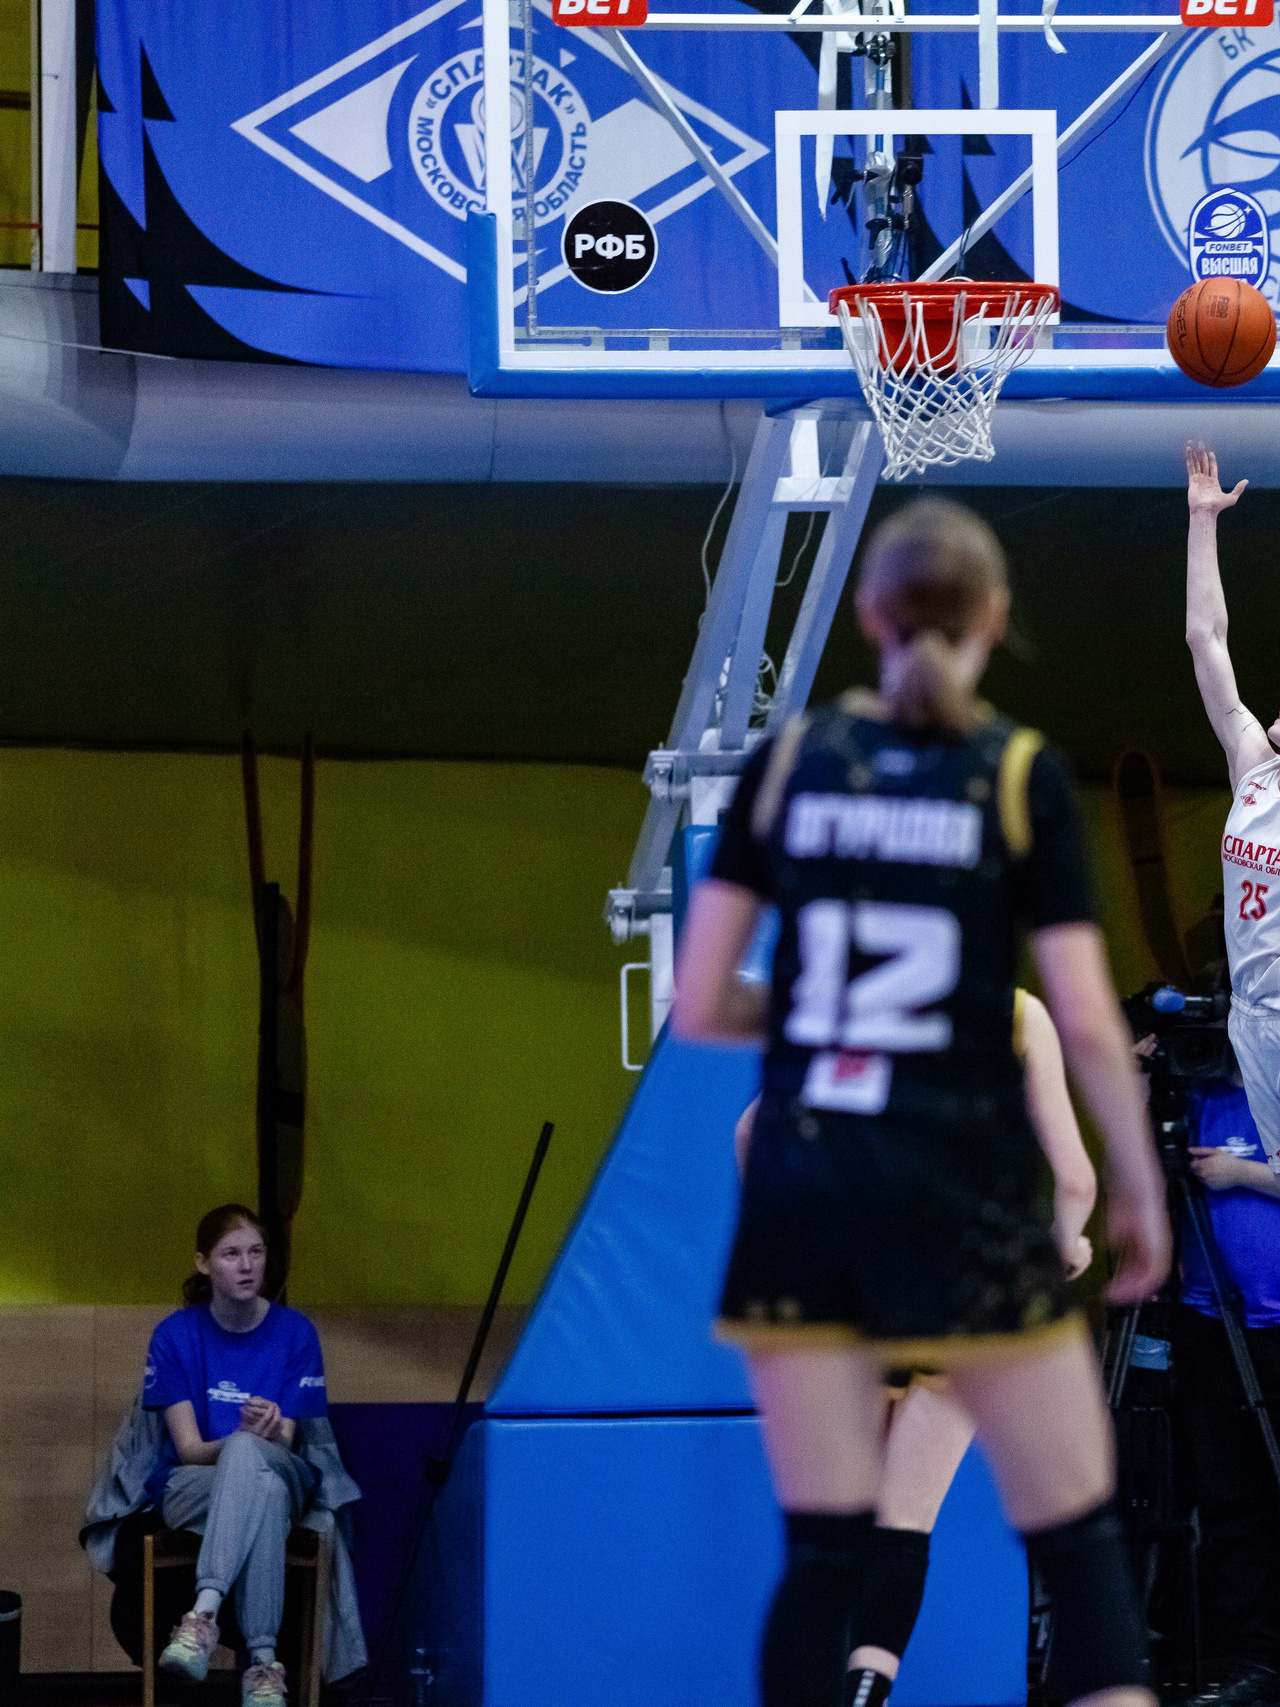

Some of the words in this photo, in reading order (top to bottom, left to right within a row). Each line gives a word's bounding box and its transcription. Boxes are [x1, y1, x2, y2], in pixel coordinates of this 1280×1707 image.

[426, 54, 576, 114] «СПАТАК»
[534, 121, 588, 218] ОБЛАСТЬ
[574, 233, 647, 260] РФБ
[1201, 257, 1258, 276] ВЫСШАЯ
[1208, 243, 1250, 252] FONBET
[1239, 879, 1270, 921] 25
[785, 898, 962, 1051] 12
